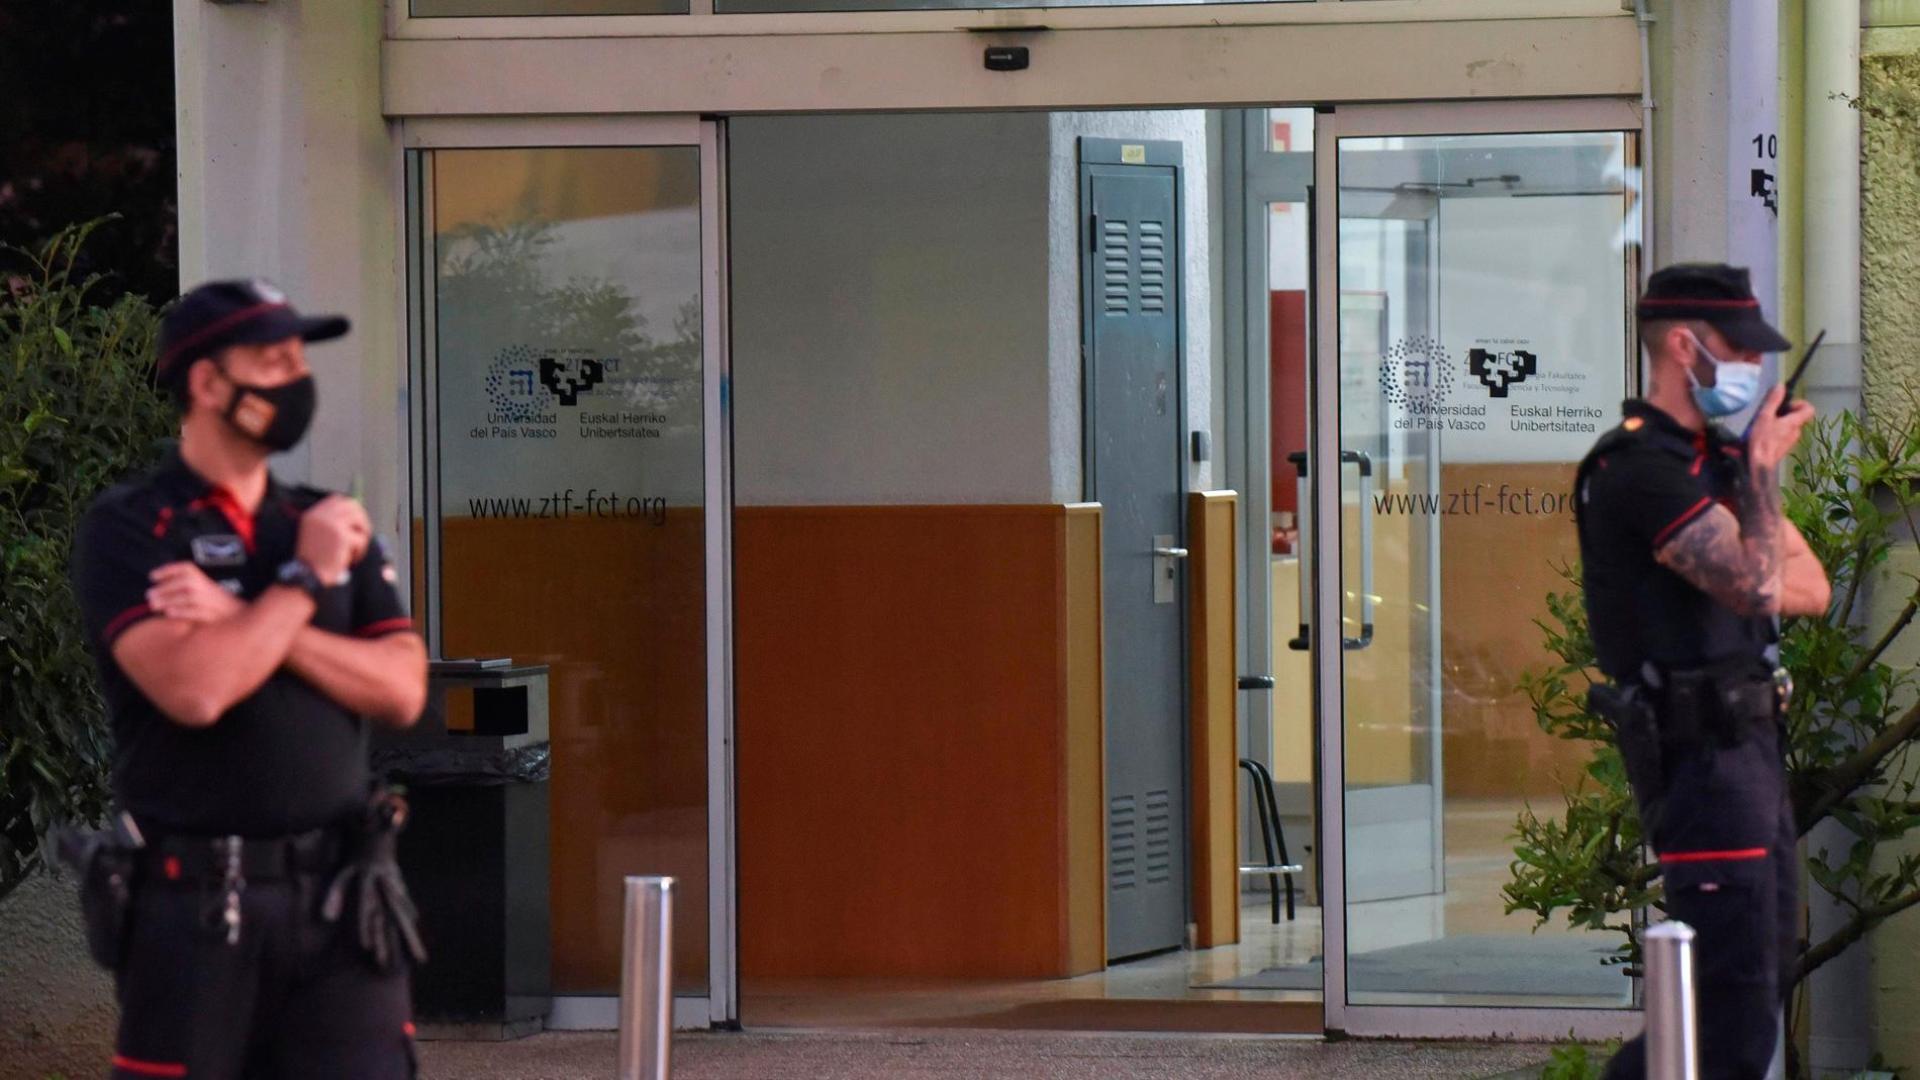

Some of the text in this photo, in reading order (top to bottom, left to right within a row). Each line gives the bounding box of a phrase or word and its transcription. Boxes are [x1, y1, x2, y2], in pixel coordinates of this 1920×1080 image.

[1412, 404, 1486, 416] Universidad
[1511, 405, 1602, 418] Euskal Herriko
[487, 412, 557, 424] Universidad
[580, 412, 666, 424] Euskal Herriko
[1394, 418, 1413, 429] del
[1448, 420, 1486, 430] Vasco
[1510, 420, 1595, 432] Unibertsitatea
[470, 427, 488, 438] del
[520, 427, 557, 438] Vasco
[580, 427, 660, 438] Unibertsitatea
[469, 489, 666, 527] www.ztf-fct.org
